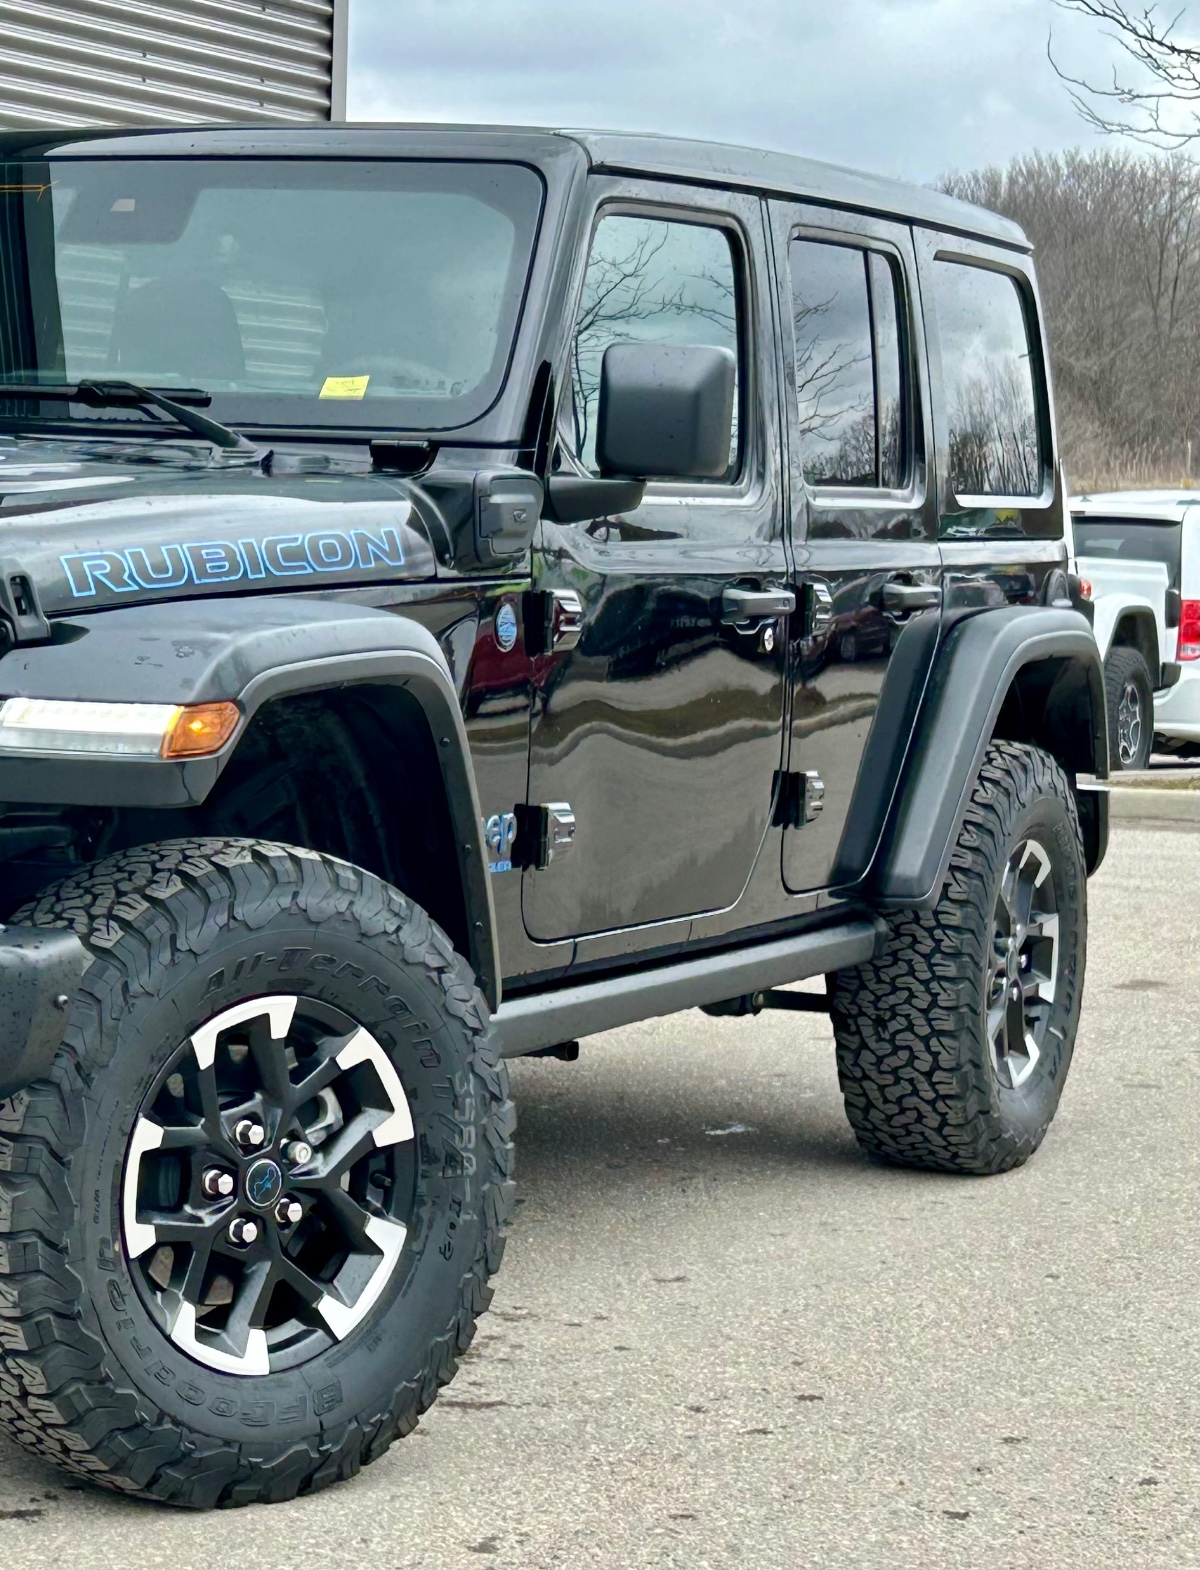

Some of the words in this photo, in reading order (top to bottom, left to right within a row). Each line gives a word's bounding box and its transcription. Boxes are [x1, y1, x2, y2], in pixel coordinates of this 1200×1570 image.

[59, 528, 405, 598] RUBICON
[198, 945, 442, 1069] All-Terrain
[97, 1236, 345, 1428] BFGoodrich
